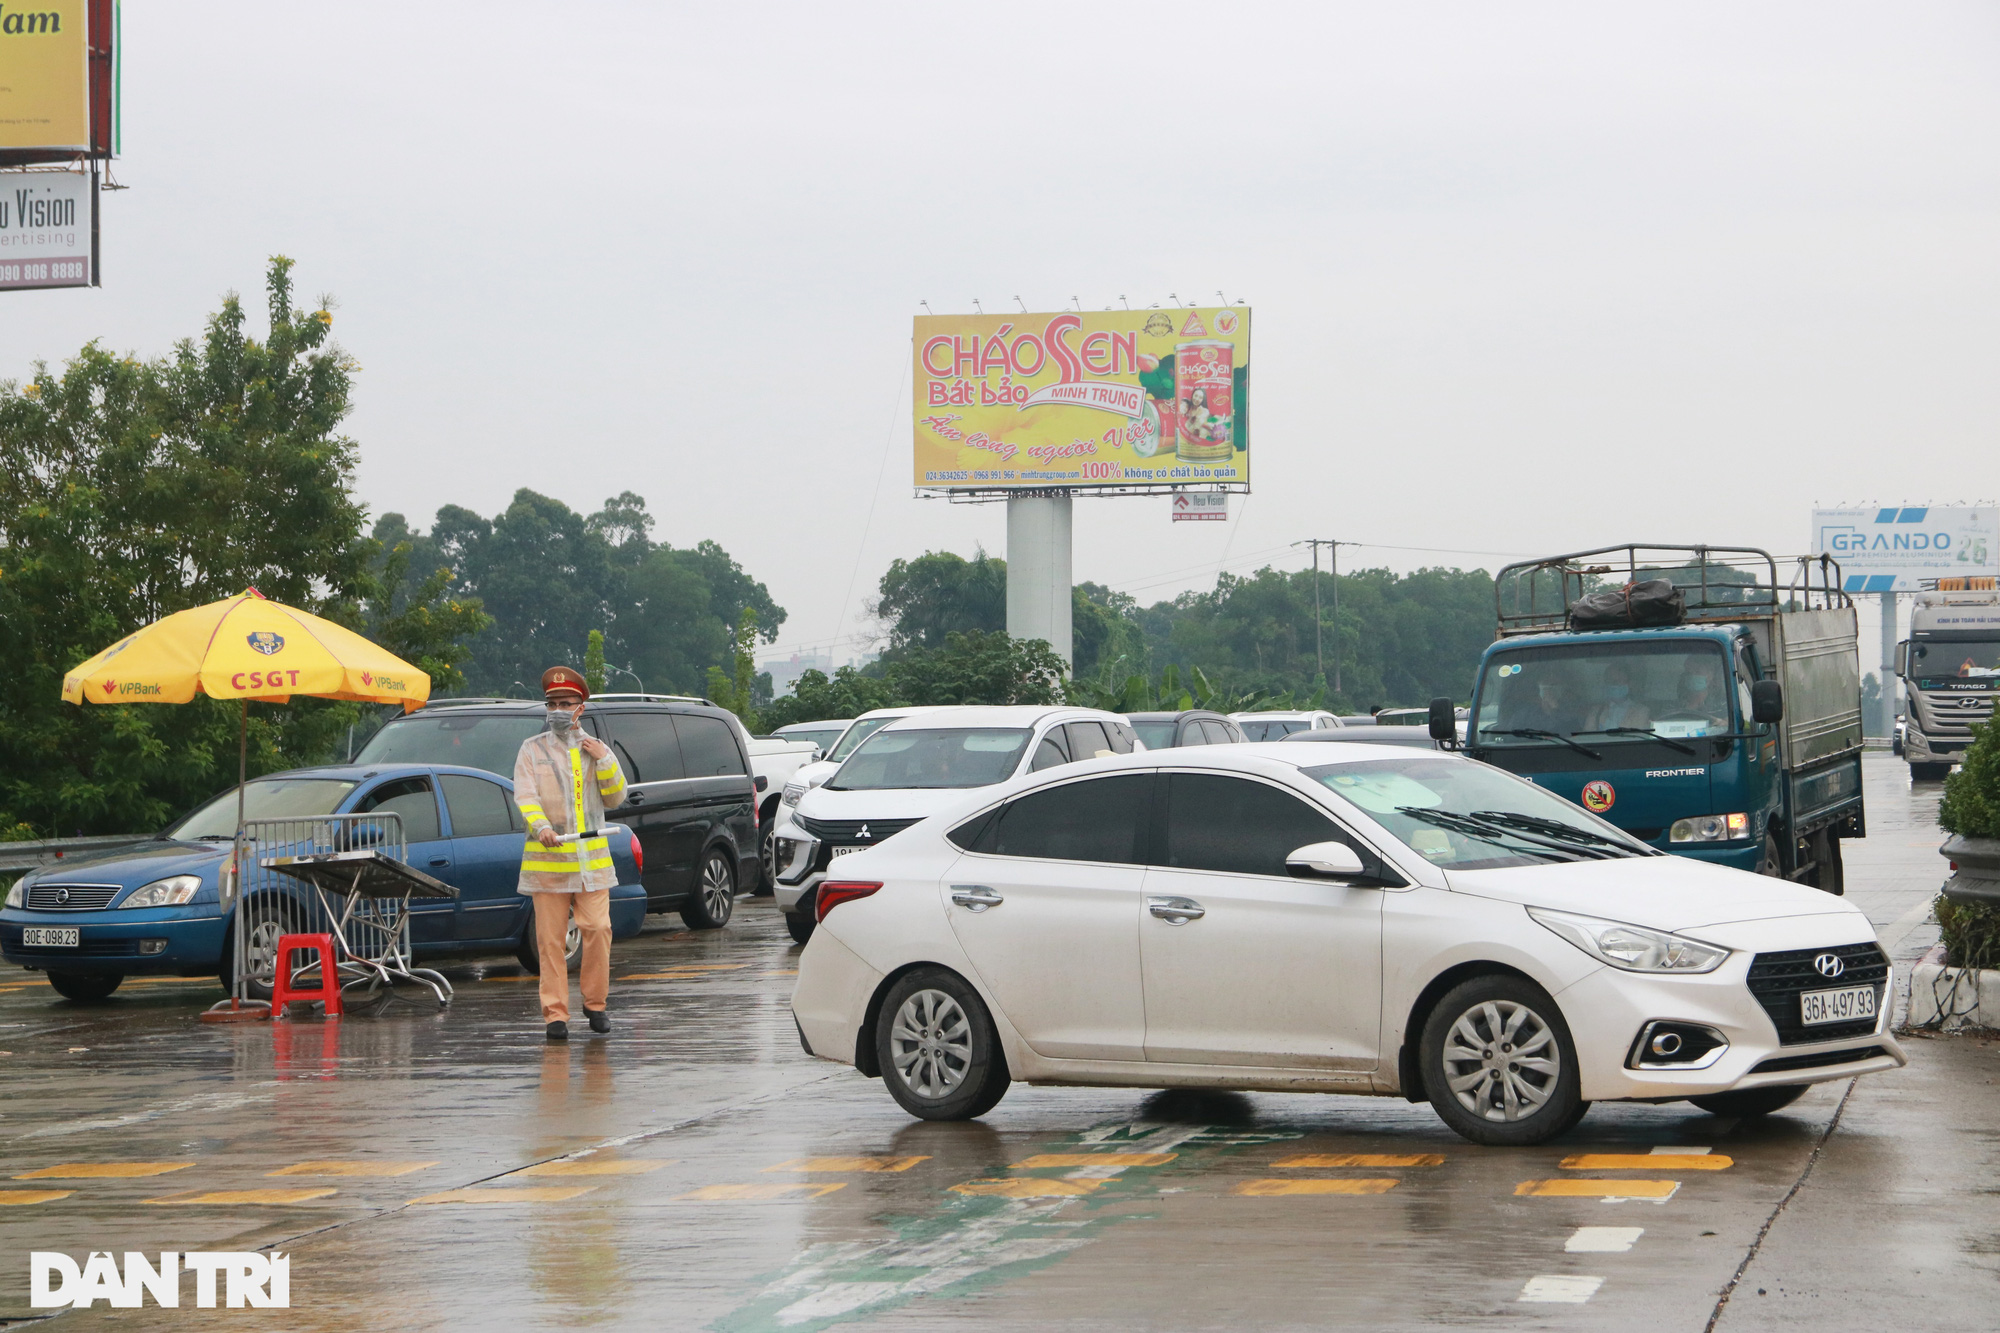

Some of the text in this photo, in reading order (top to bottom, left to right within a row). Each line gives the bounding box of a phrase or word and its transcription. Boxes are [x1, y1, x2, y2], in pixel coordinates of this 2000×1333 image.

[0, 4, 61, 34] am
[16, 187, 75, 228] Vision
[24, 263, 48, 280] 806
[52, 261, 83, 279] 8888
[928, 376, 1029, 405] Bát bảo
[1051, 387, 1138, 410] MINH TRUNG
[965, 432, 1019, 461] lòng
[1027, 439, 1097, 464] người
[1102, 418, 1154, 448] Việt
[1021, 470, 1080, 480] minhtrunggroup.com
[1082, 461, 1121, 479] 100%
[1124, 467, 1153, 479] không
[1156, 467, 1167, 478] có
[1170, 465, 1191, 477] chất
[1194, 465, 1211, 477] bảo
[1214, 465, 1236, 478] quản
[1831, 533, 1951, 550] GRANDO
[1856, 551, 1897, 559] PREMIUM
[120, 682, 161, 695] VPBank
[231, 669, 300, 690] CSGT
[374, 676, 406, 692] VPBank
[1645, 767, 1705, 778] FRONTIER
[24, 929, 77, 945] 30E-098.23
[1803, 989, 1874, 1021] 36A-497.93
